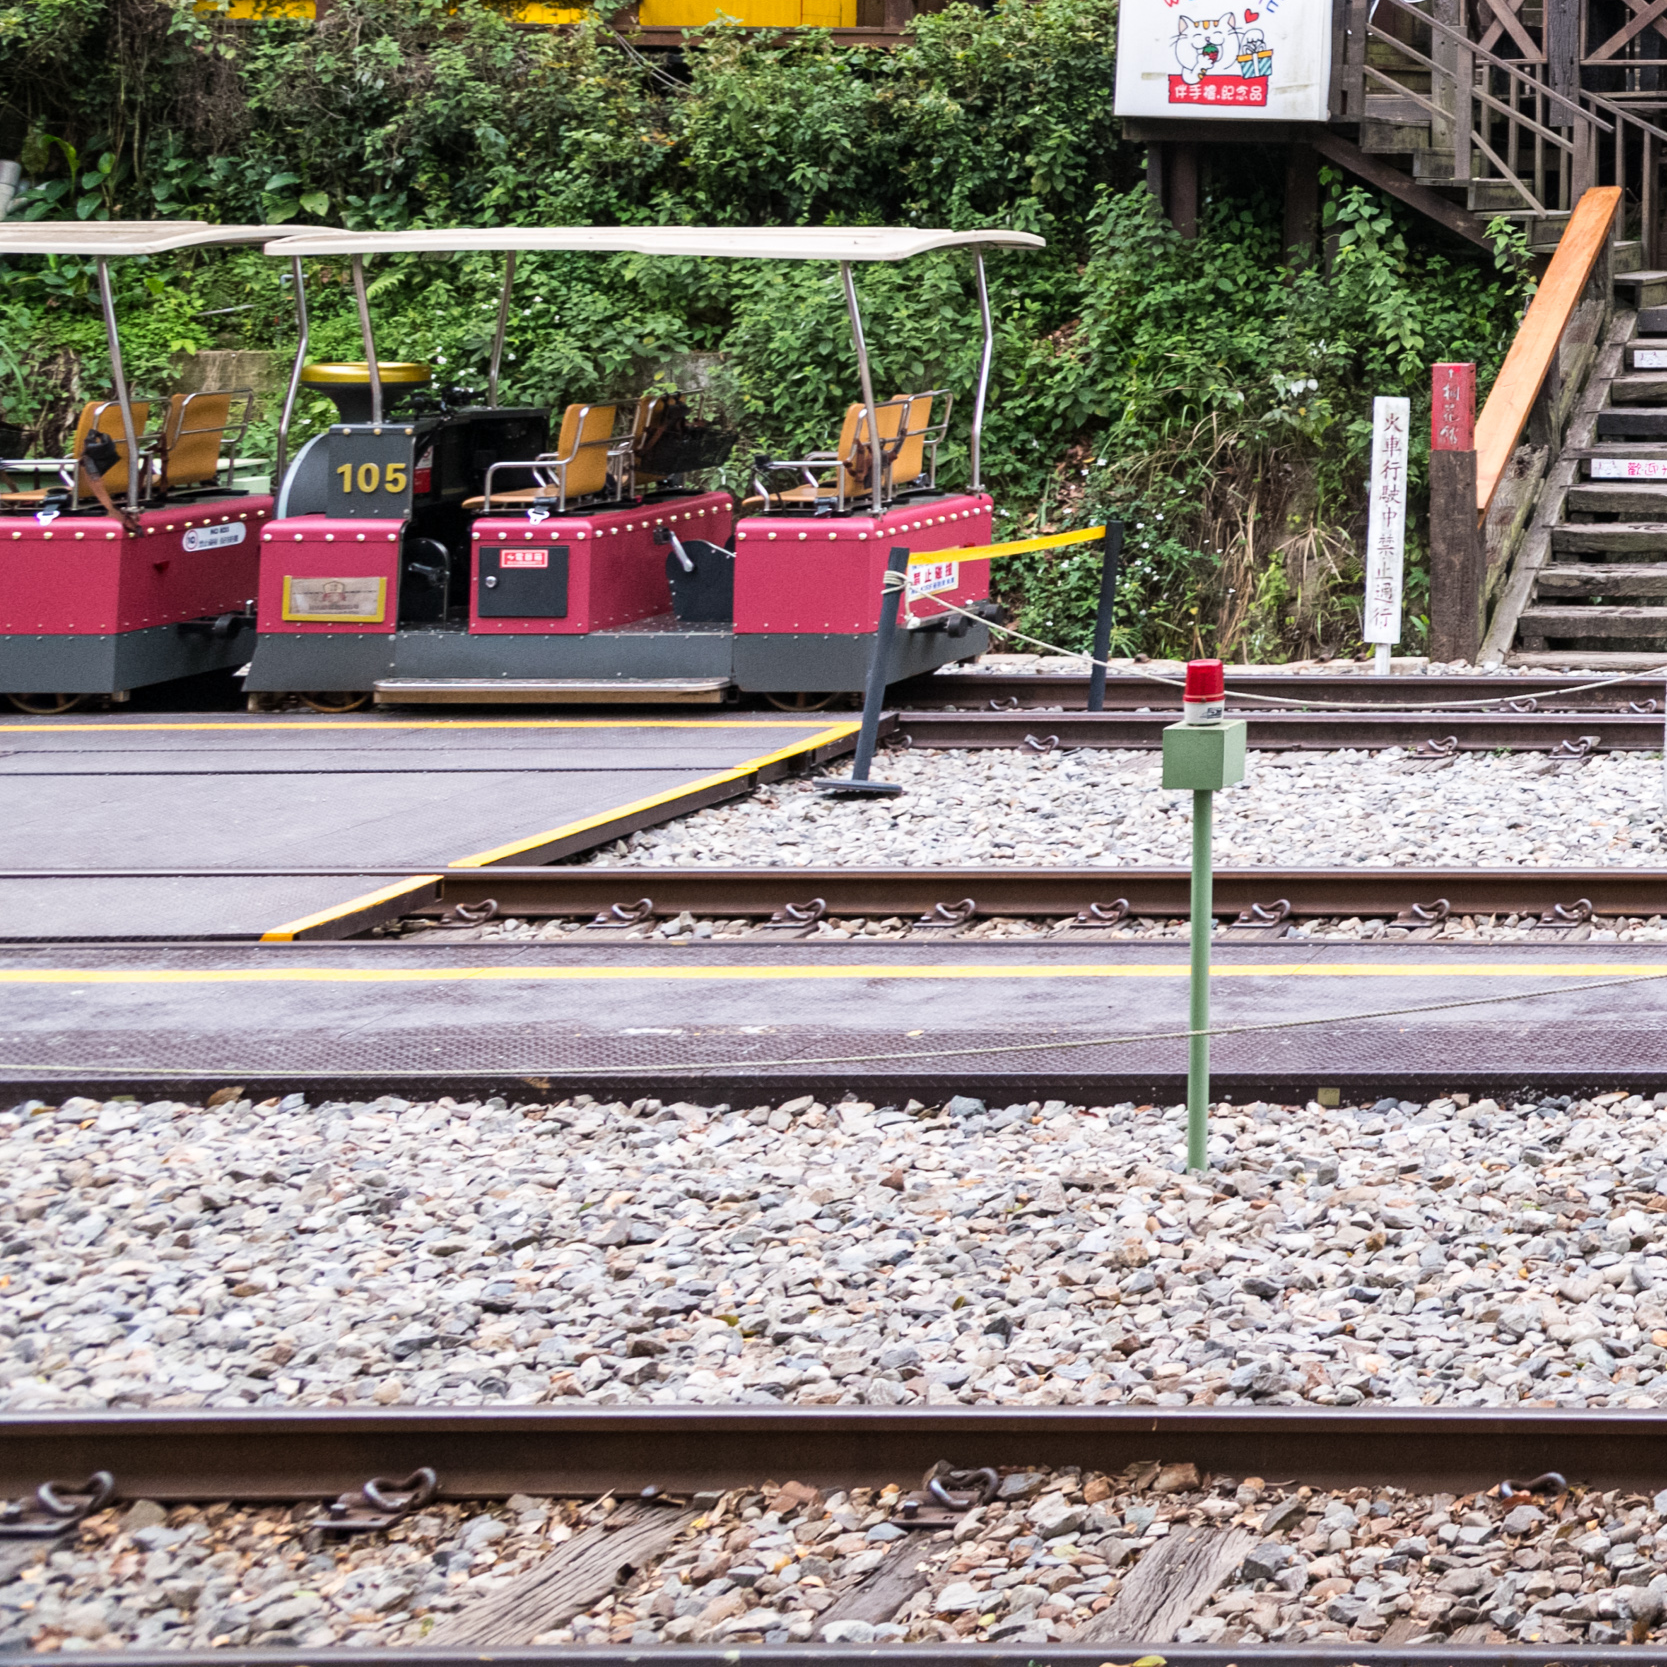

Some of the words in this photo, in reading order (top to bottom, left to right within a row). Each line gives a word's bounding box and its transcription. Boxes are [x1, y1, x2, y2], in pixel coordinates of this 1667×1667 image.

[336, 462, 408, 493] 105
[1373, 412, 1403, 629] 火車行駛中禁止通行
